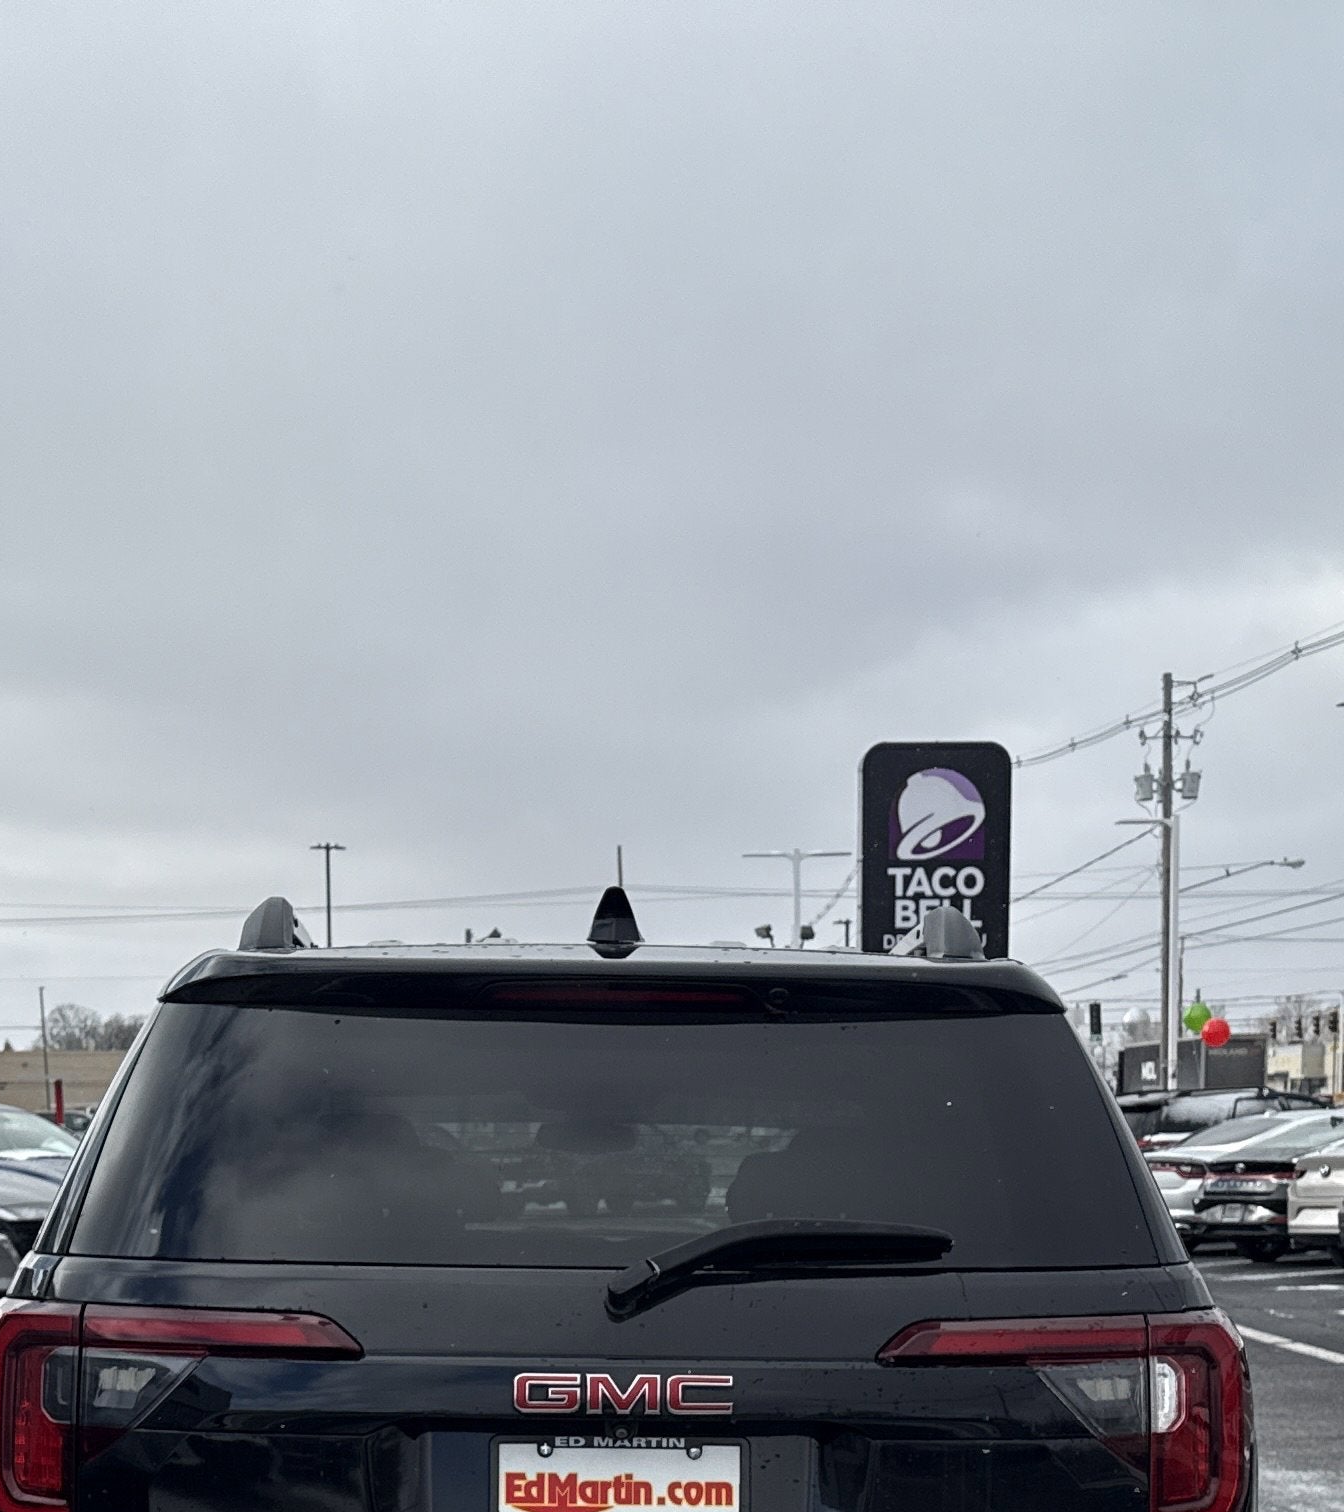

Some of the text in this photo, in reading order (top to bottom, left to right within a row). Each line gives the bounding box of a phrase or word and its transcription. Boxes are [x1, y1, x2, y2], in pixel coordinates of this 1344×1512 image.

[886, 866, 985, 897] TACO
[513, 1372, 733, 1415] GMC
[555, 1436, 686, 1448] ED MARTIN
[505, 1472, 734, 1509] EdMartin.com
